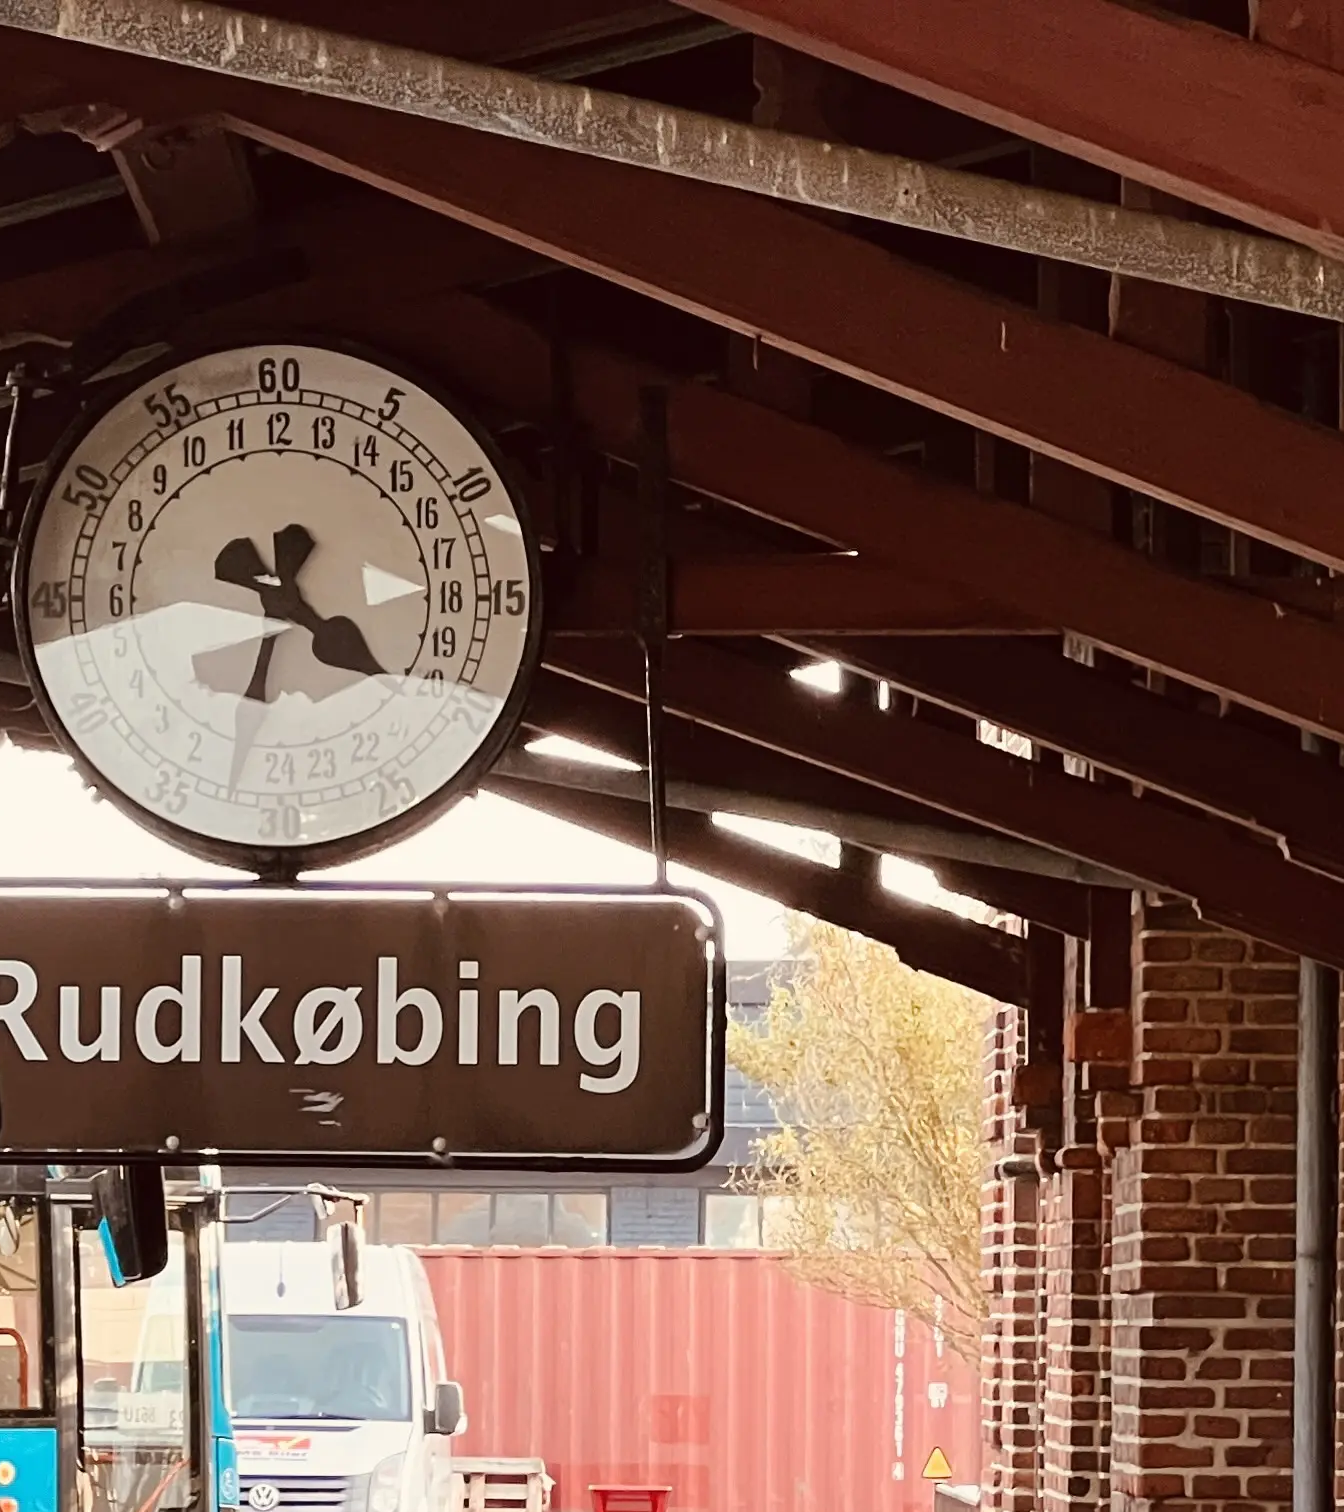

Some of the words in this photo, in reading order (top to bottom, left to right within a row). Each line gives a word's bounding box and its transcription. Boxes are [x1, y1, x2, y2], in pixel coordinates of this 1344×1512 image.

[259, 358, 300, 393] 60
[144, 383, 191, 428] 55
[378, 387, 407, 421] 5
[227, 418, 244, 450] 11
[267, 412, 292, 445] 12
[312, 416, 336, 449] 13
[183, 436, 205, 467] 10
[354, 435, 380, 466] 14
[62, 464, 108, 511] 50
[154, 464, 167, 495] 9
[390, 460, 414, 492] 15
[453, 467, 492, 502] 10
[128, 500, 143, 531] 8
[416, 497, 438, 528] 16
[112, 541, 127, 571] 7
[433, 538, 456, 569] 17
[31, 581, 66, 618] 45
[110, 584, 123, 616] 6
[440, 581, 462, 613] 18
[493, 580, 525, 616] 15
[113, 627, 127, 657] 5
[432, 627, 456, 657] 19
[129, 670, 144, 698] 4
[416, 669, 444, 698] 20
[68, 693, 109, 735] 40
[156, 704, 170, 734] 3
[452, 690, 496, 735] 20
[187, 732, 202, 763] 2
[351, 733, 380, 763] 22
[265, 753, 295, 785] 24
[308, 749, 336, 779] 23
[145, 770, 191, 815] 35
[370, 769, 416, 817] 25
[258, 805, 301, 840] 30
